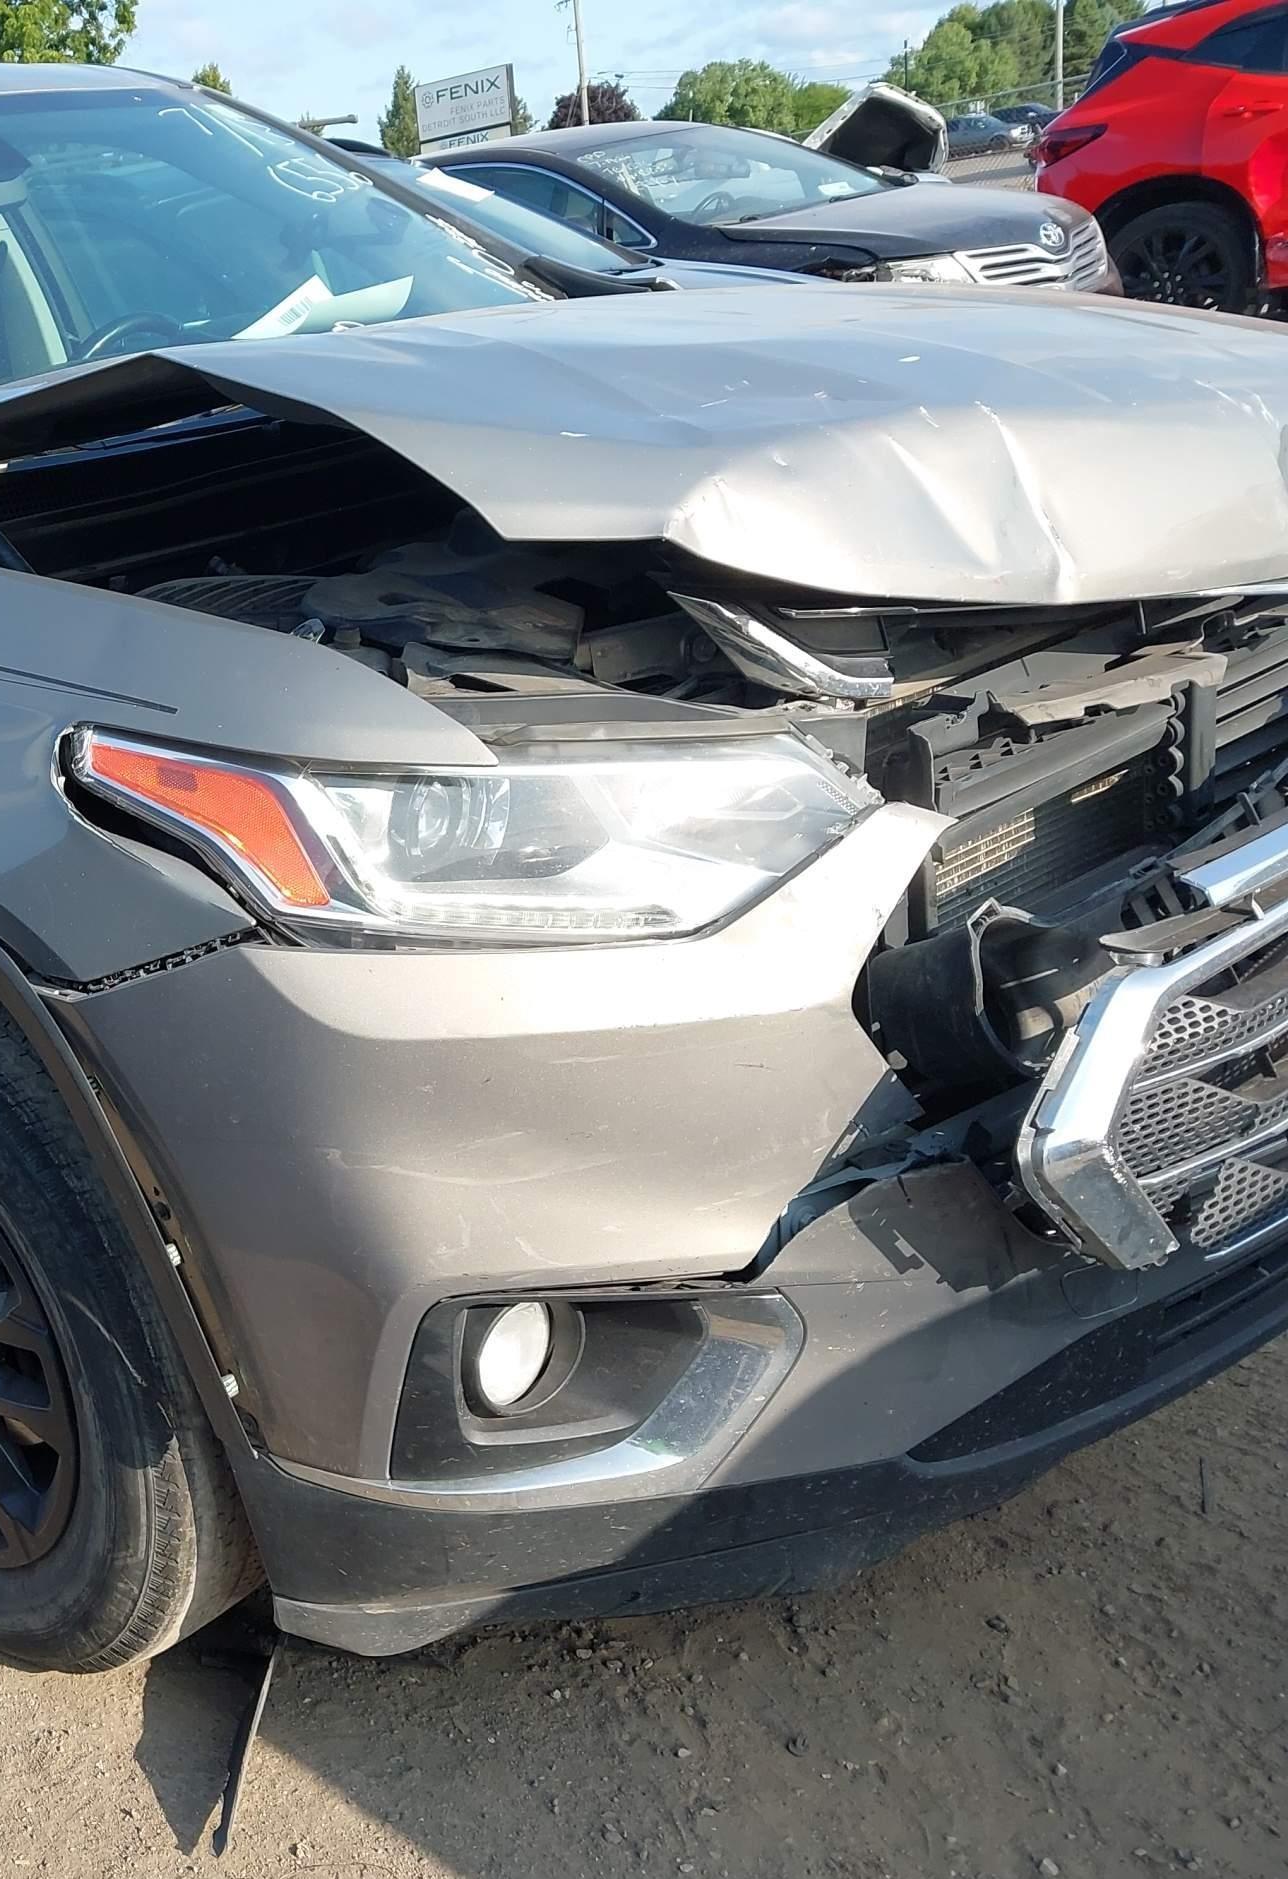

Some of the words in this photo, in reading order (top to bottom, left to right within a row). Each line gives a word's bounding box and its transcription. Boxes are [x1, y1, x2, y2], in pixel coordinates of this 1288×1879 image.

[436, 75, 501, 104] FENIX
[477, 96, 505, 109] PARTS
[422, 118, 456, 133] DETROIT
[459, 111, 488, 124] SOUTH
[448, 132, 489, 149] FENIX
